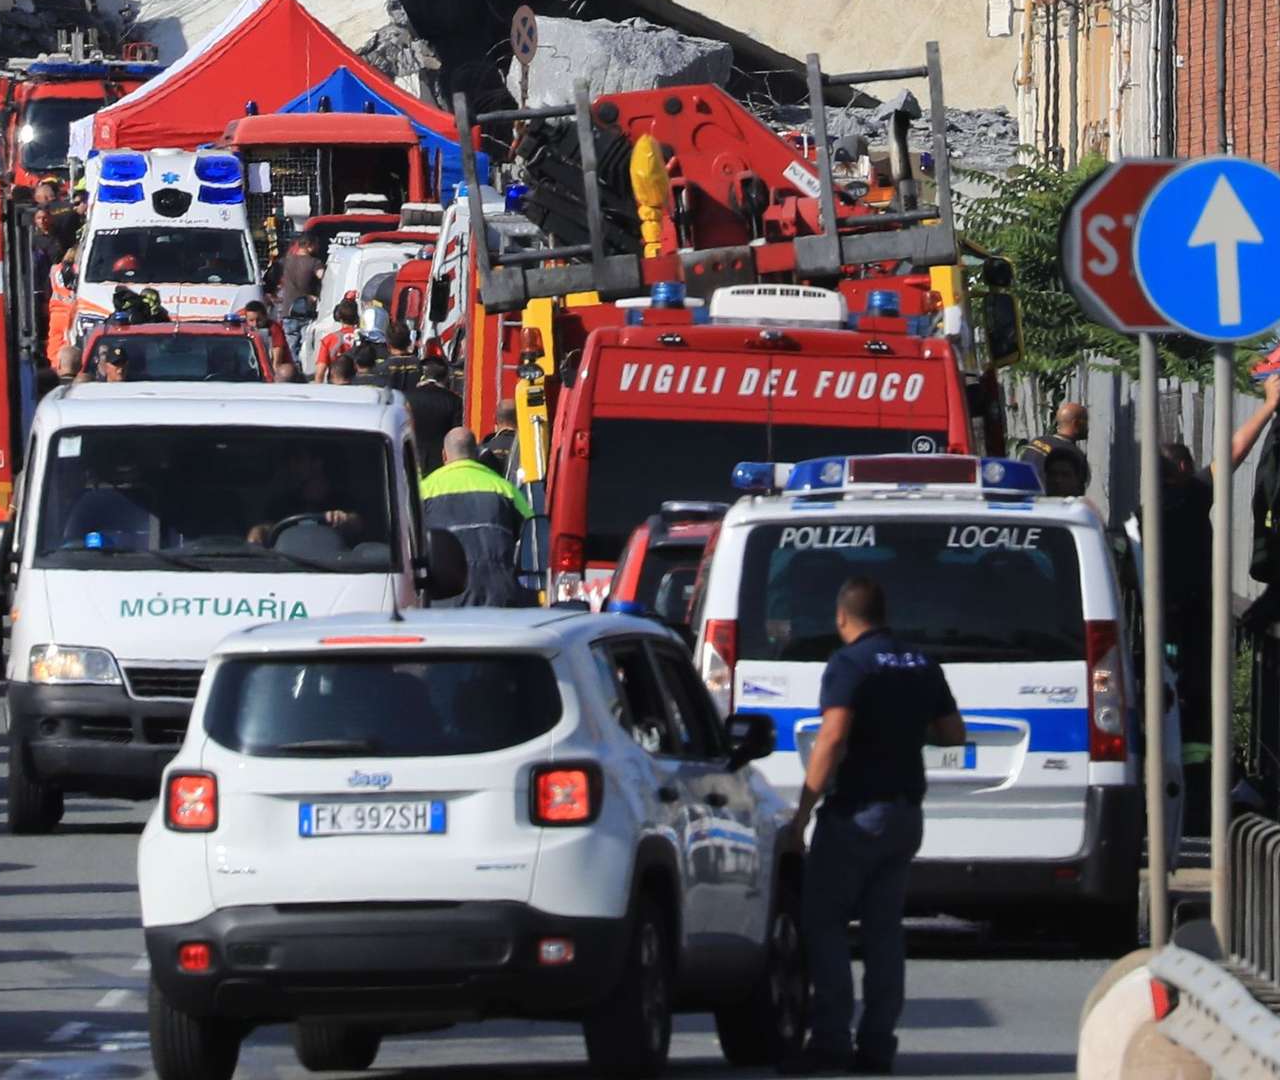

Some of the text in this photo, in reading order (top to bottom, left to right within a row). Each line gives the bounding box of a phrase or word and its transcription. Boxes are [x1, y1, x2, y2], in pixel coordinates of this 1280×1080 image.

[1087, 214, 1134, 276] S
[619, 363, 925, 402] VIGILI DEL FUOCO
[779, 525, 1041, 549] POLIZIA LOCALE
[120, 597, 309, 620] MORTUARIA
[315, 804, 343, 830] FK
[354, 803, 428, 829] 992SH
